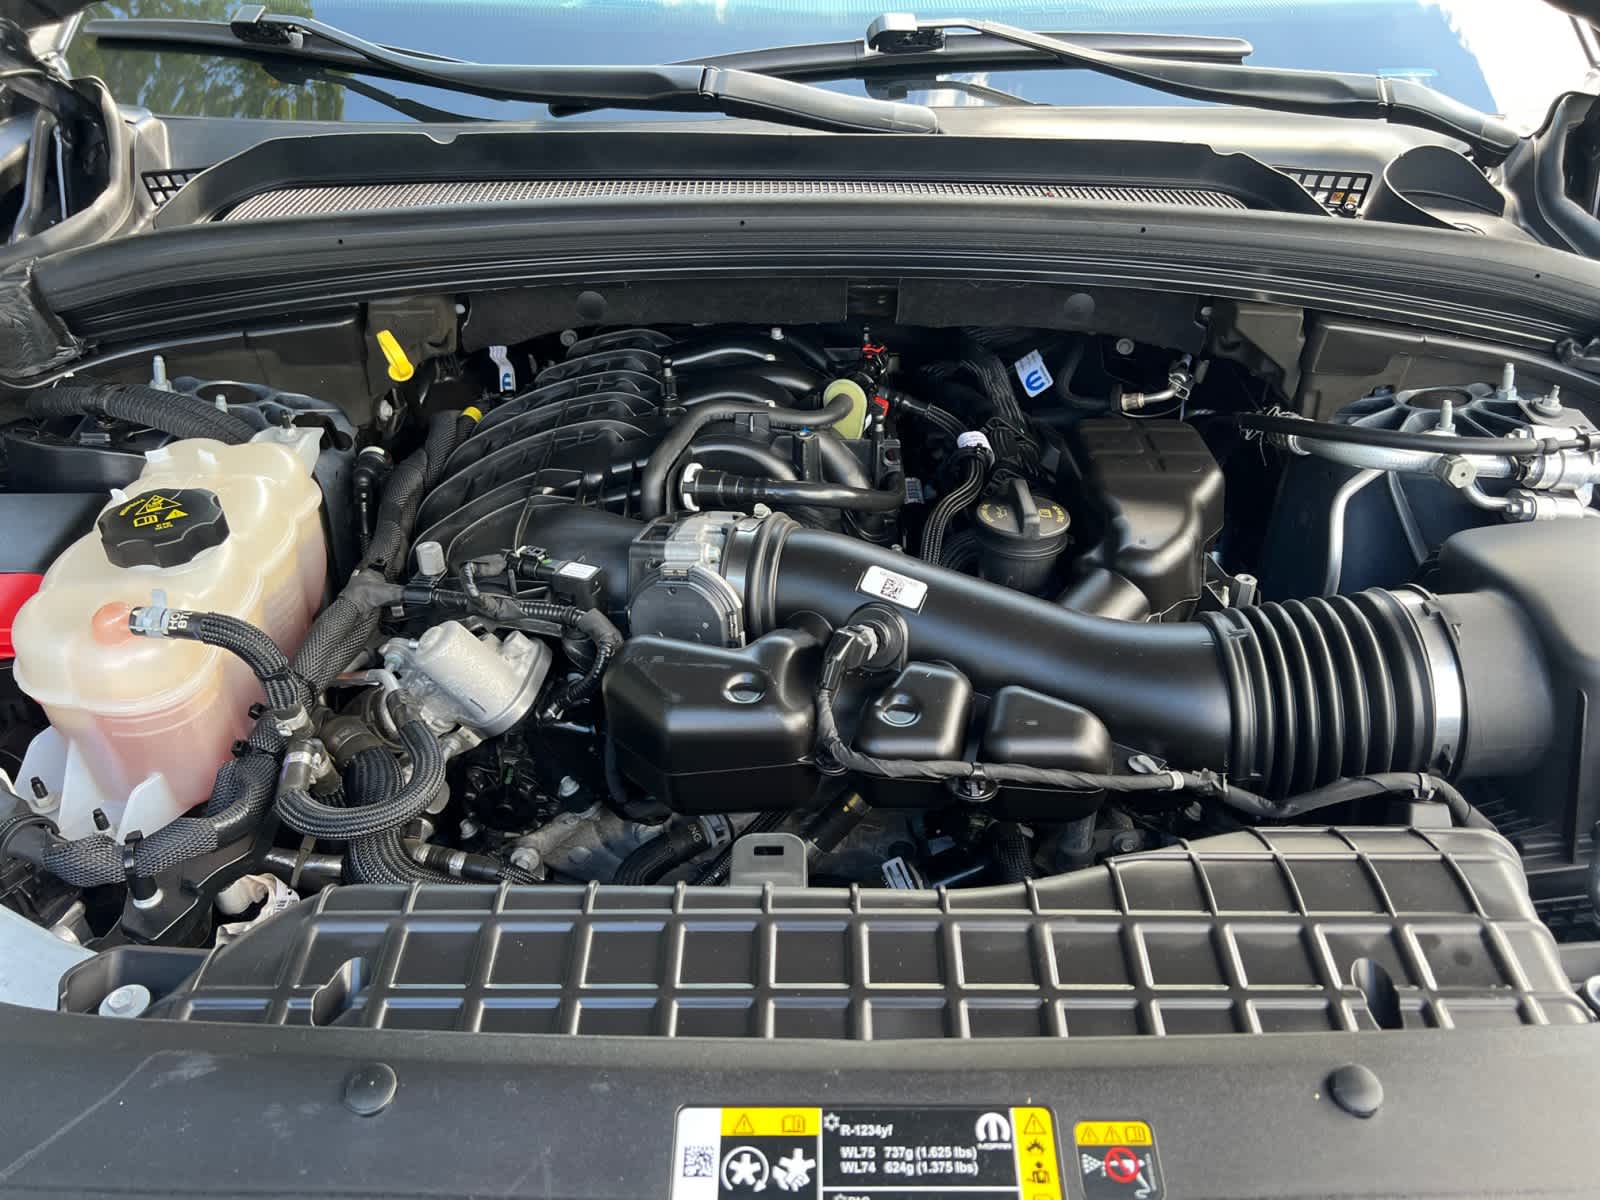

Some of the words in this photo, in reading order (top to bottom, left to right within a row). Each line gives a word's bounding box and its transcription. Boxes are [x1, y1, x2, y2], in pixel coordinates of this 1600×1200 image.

[840, 1124, 893, 1139] R-1234yf
[840, 1146, 876, 1159] WL75
[883, 1146, 914, 1161] 737g
[915, 1146, 953, 1161] (1.625
[953, 1146, 978, 1161] lbs)
[840, 1161, 876, 1174] WL74
[883, 1161, 914, 1177] 624g
[916, 1161, 954, 1177] (1.375
[954, 1161, 979, 1177] lbs)
